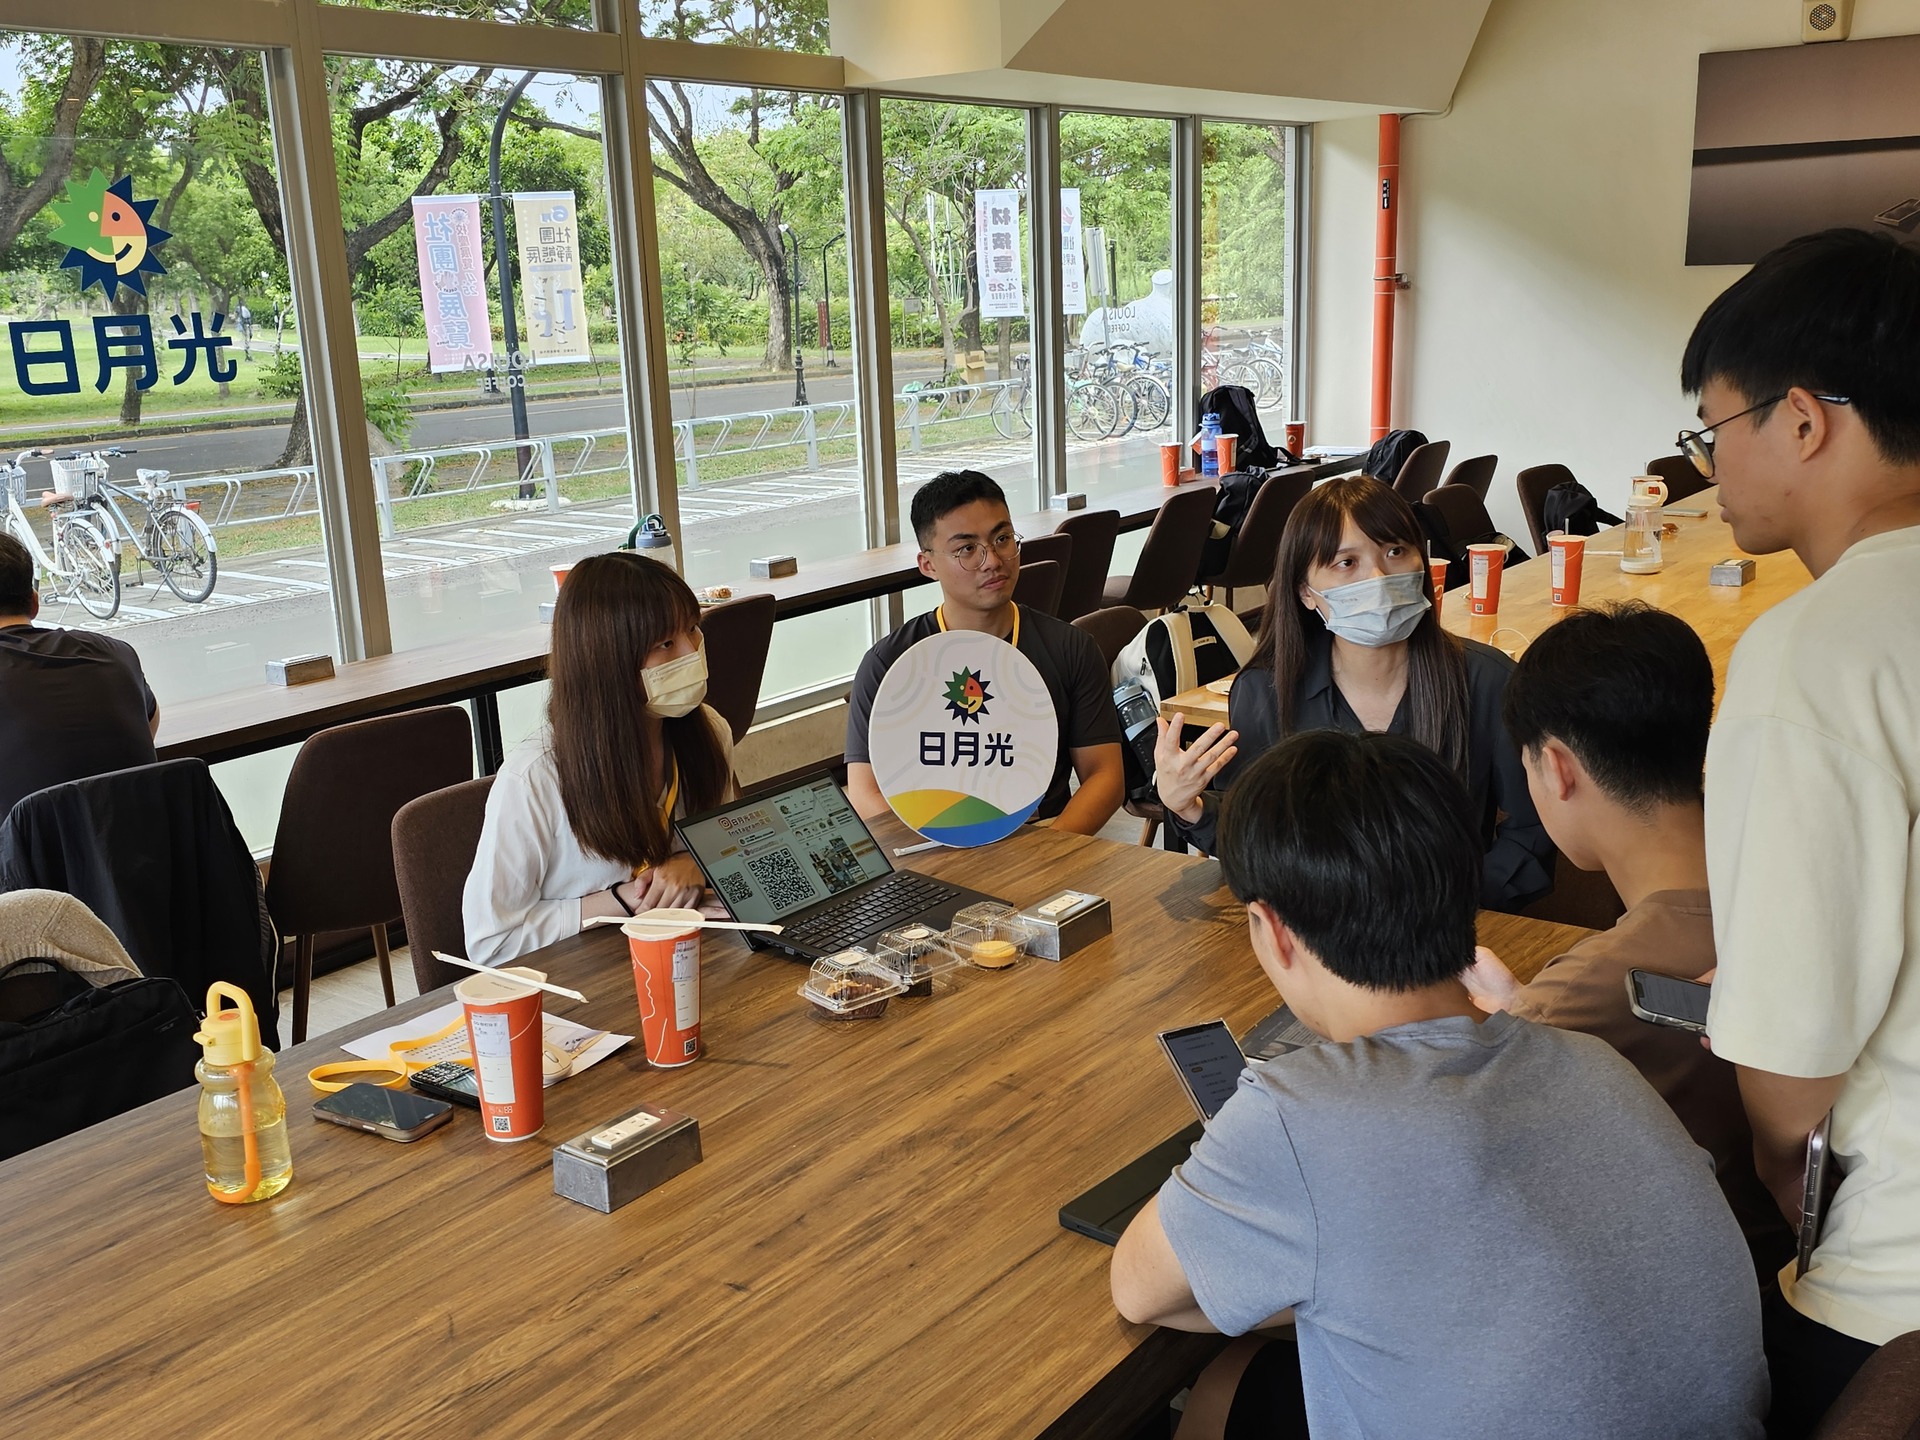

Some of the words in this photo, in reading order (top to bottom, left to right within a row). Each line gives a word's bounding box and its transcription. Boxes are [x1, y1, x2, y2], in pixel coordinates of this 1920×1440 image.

[8, 312, 238, 397] 日月光
[919, 731, 1015, 768] 日月光
